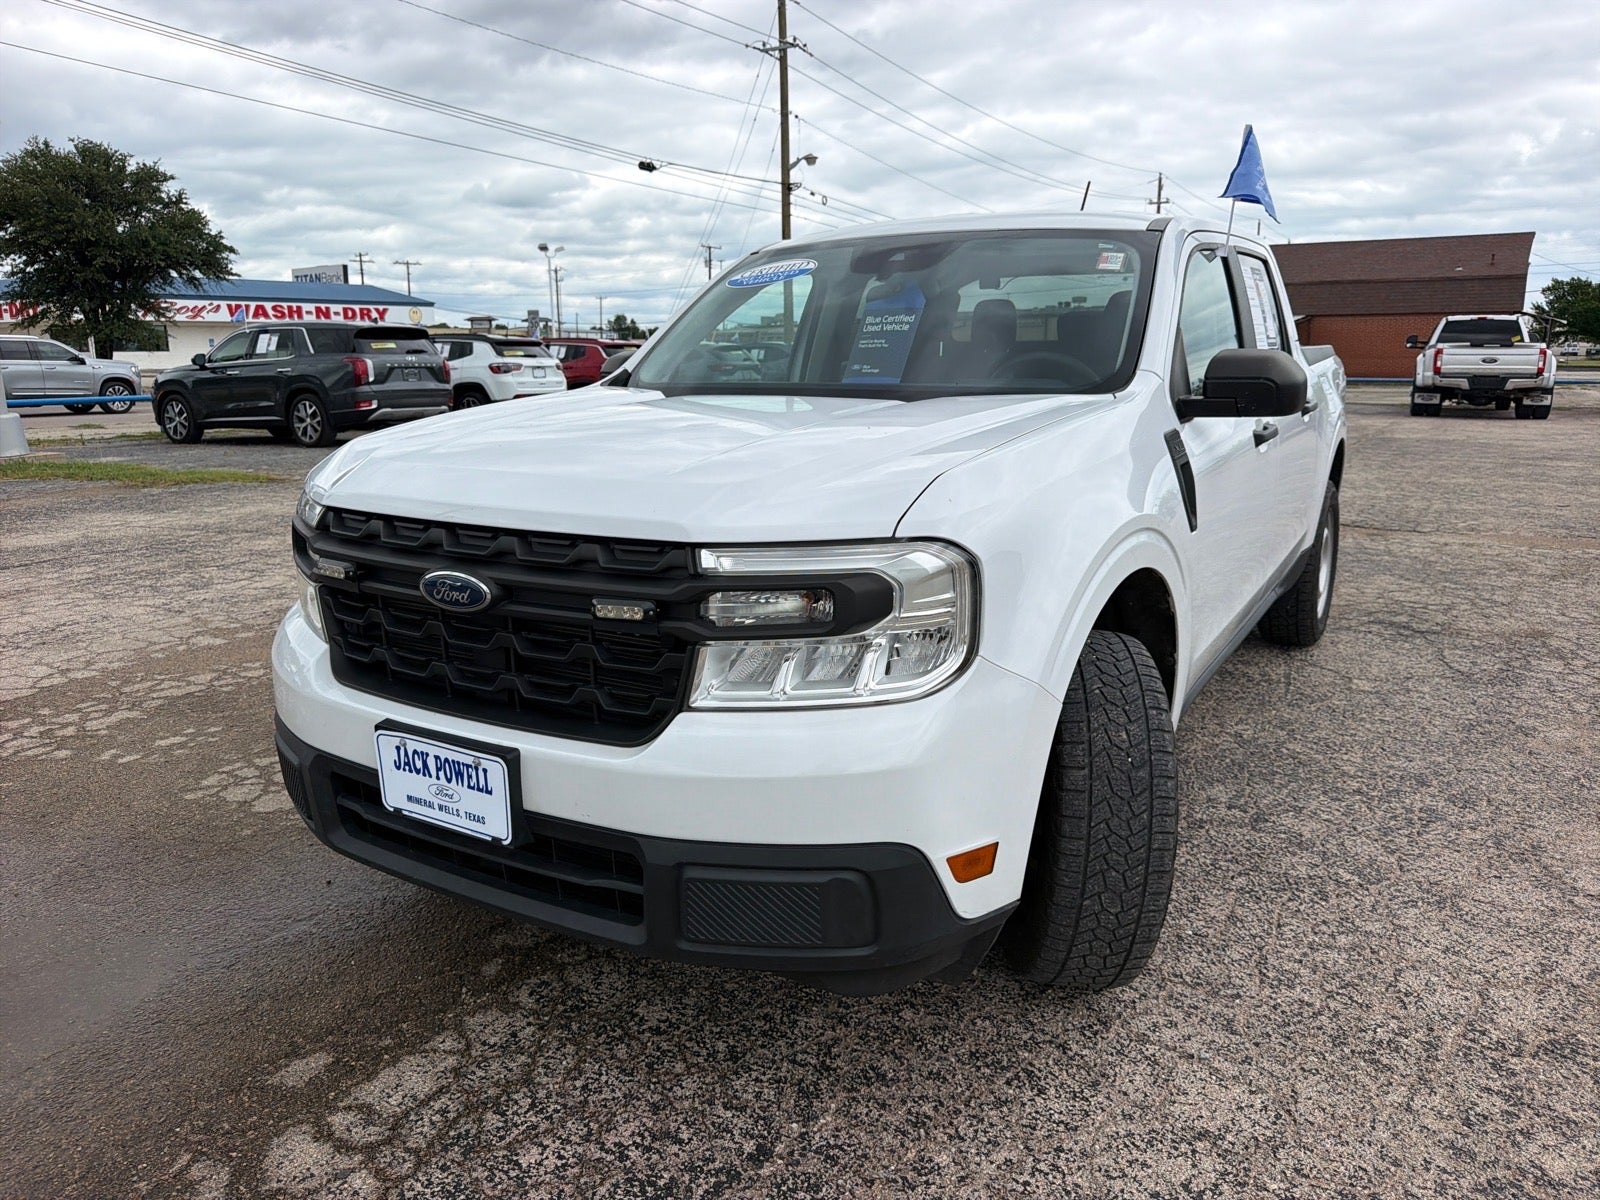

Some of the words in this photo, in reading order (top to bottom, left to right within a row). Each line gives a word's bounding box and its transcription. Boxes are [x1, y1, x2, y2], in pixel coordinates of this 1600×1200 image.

[294, 272, 343, 283] TITANBank
[226, 303, 389, 321] WASH-N-DRY
[865, 316, 881, 324] Blue
[882, 314, 916, 323] Certified
[862, 323, 881, 332] Used
[883, 323, 910, 331] Vehicle
[433, 579, 471, 603] Ford
[394, 745, 432, 778] JACK
[433, 755, 493, 796] POWELL
[434, 787, 455, 800] Ford
[406, 794, 436, 810] MINERAL
[437, 803, 463, 819] WELLS,
[464, 811, 486, 825] TEXAS
